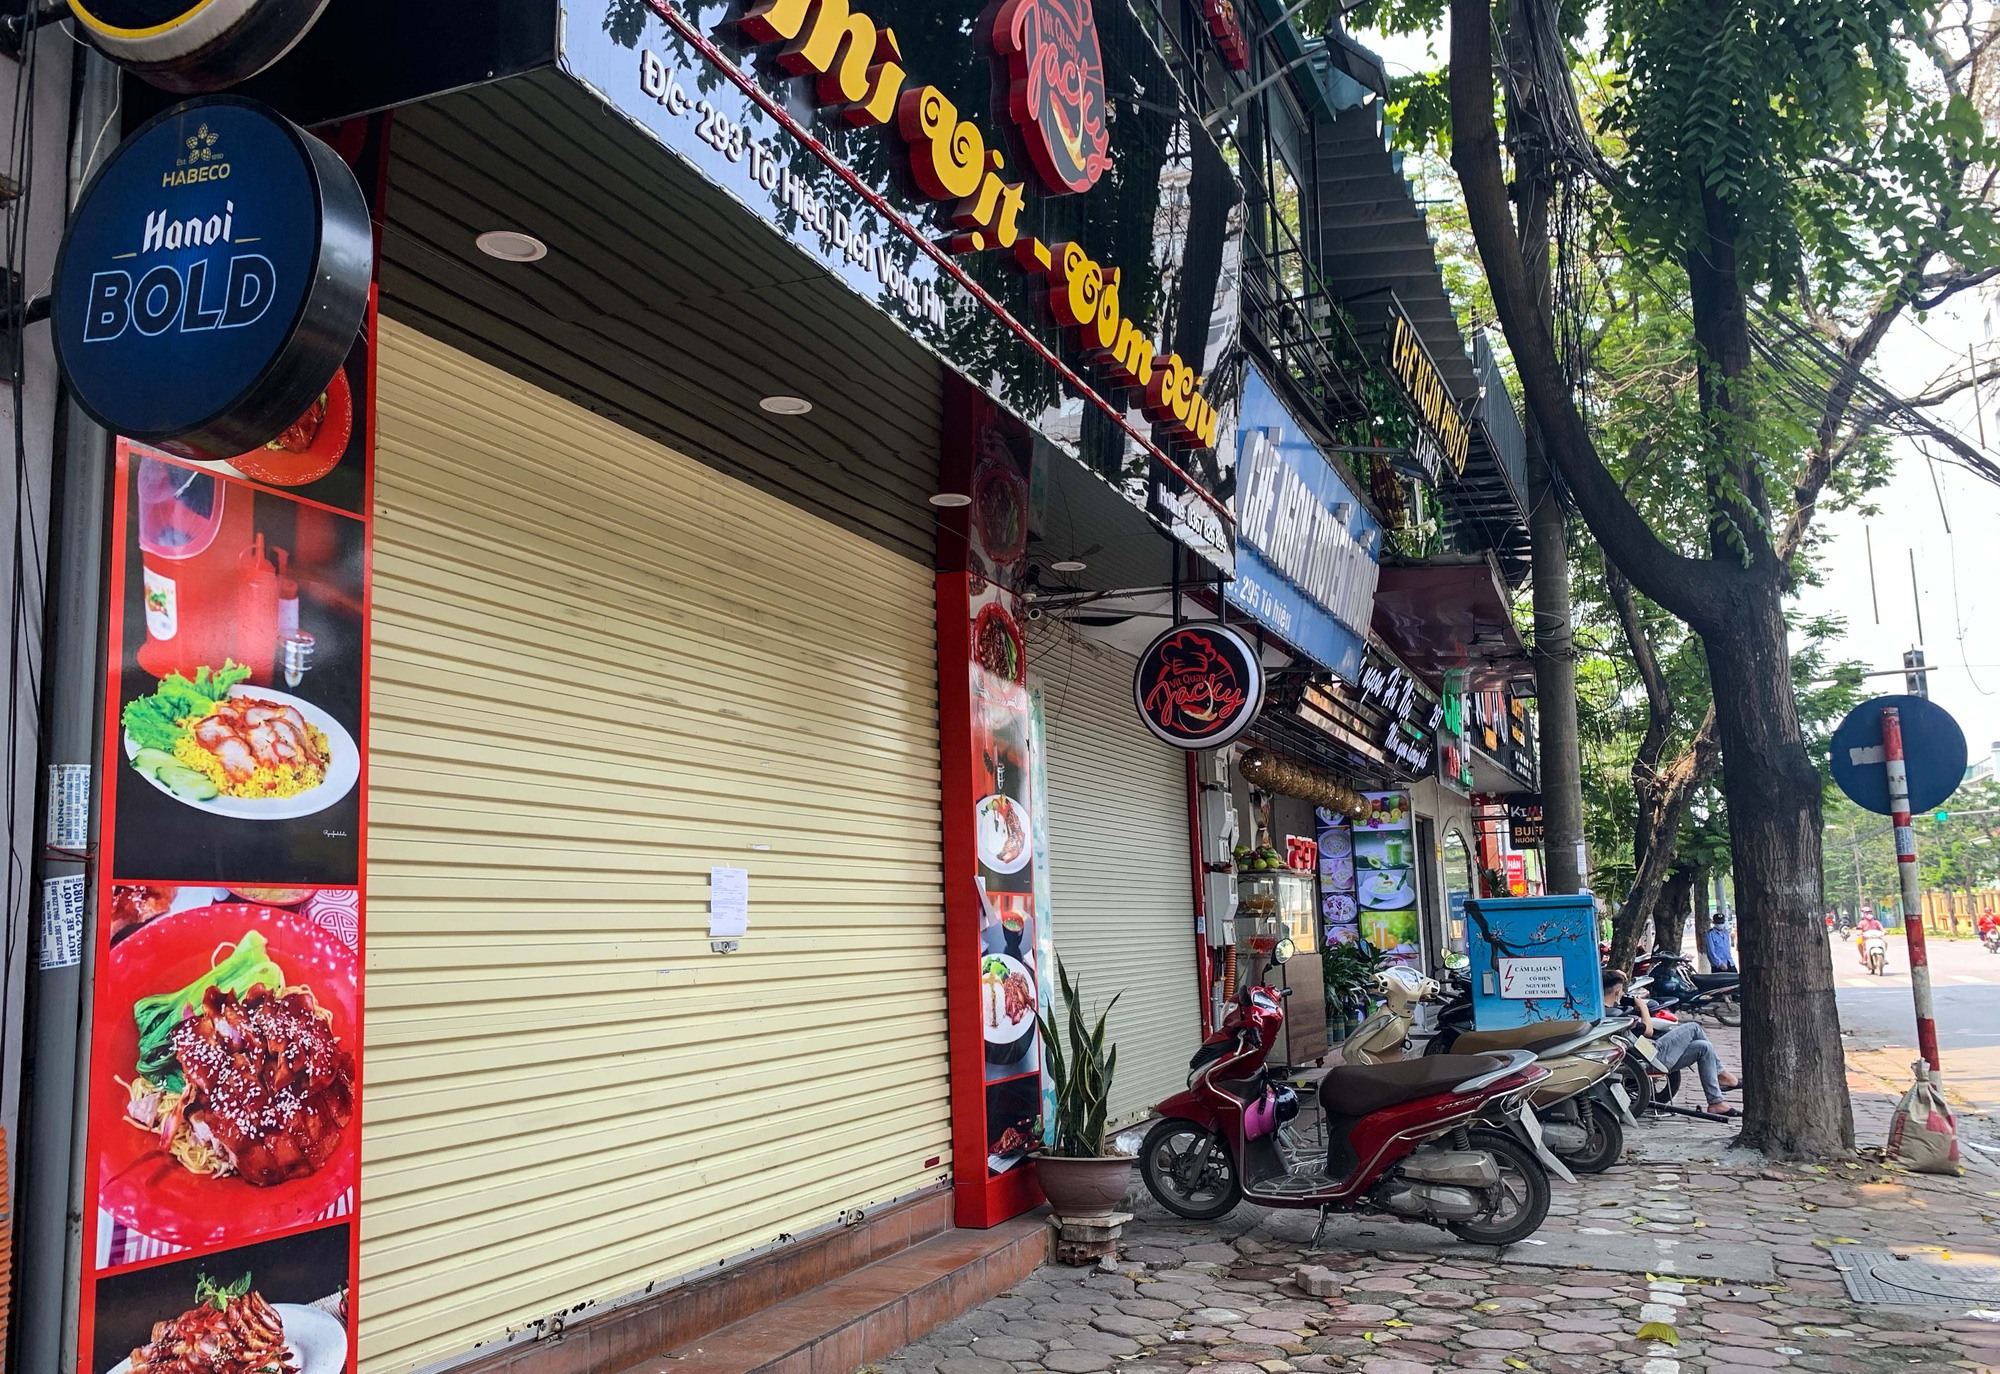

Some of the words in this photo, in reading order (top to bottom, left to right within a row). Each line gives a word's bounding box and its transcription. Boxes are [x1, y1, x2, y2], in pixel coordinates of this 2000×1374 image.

[695, 99, 744, 164] 293
[162, 163, 230, 188] HABECO
[142, 199, 234, 253] Hanoi
[83, 254, 276, 343] BOLD
[1240, 575, 1260, 609] 295
[1145, 673, 1246, 727] Jacky
[66, 934, 76, 956] HÚT
